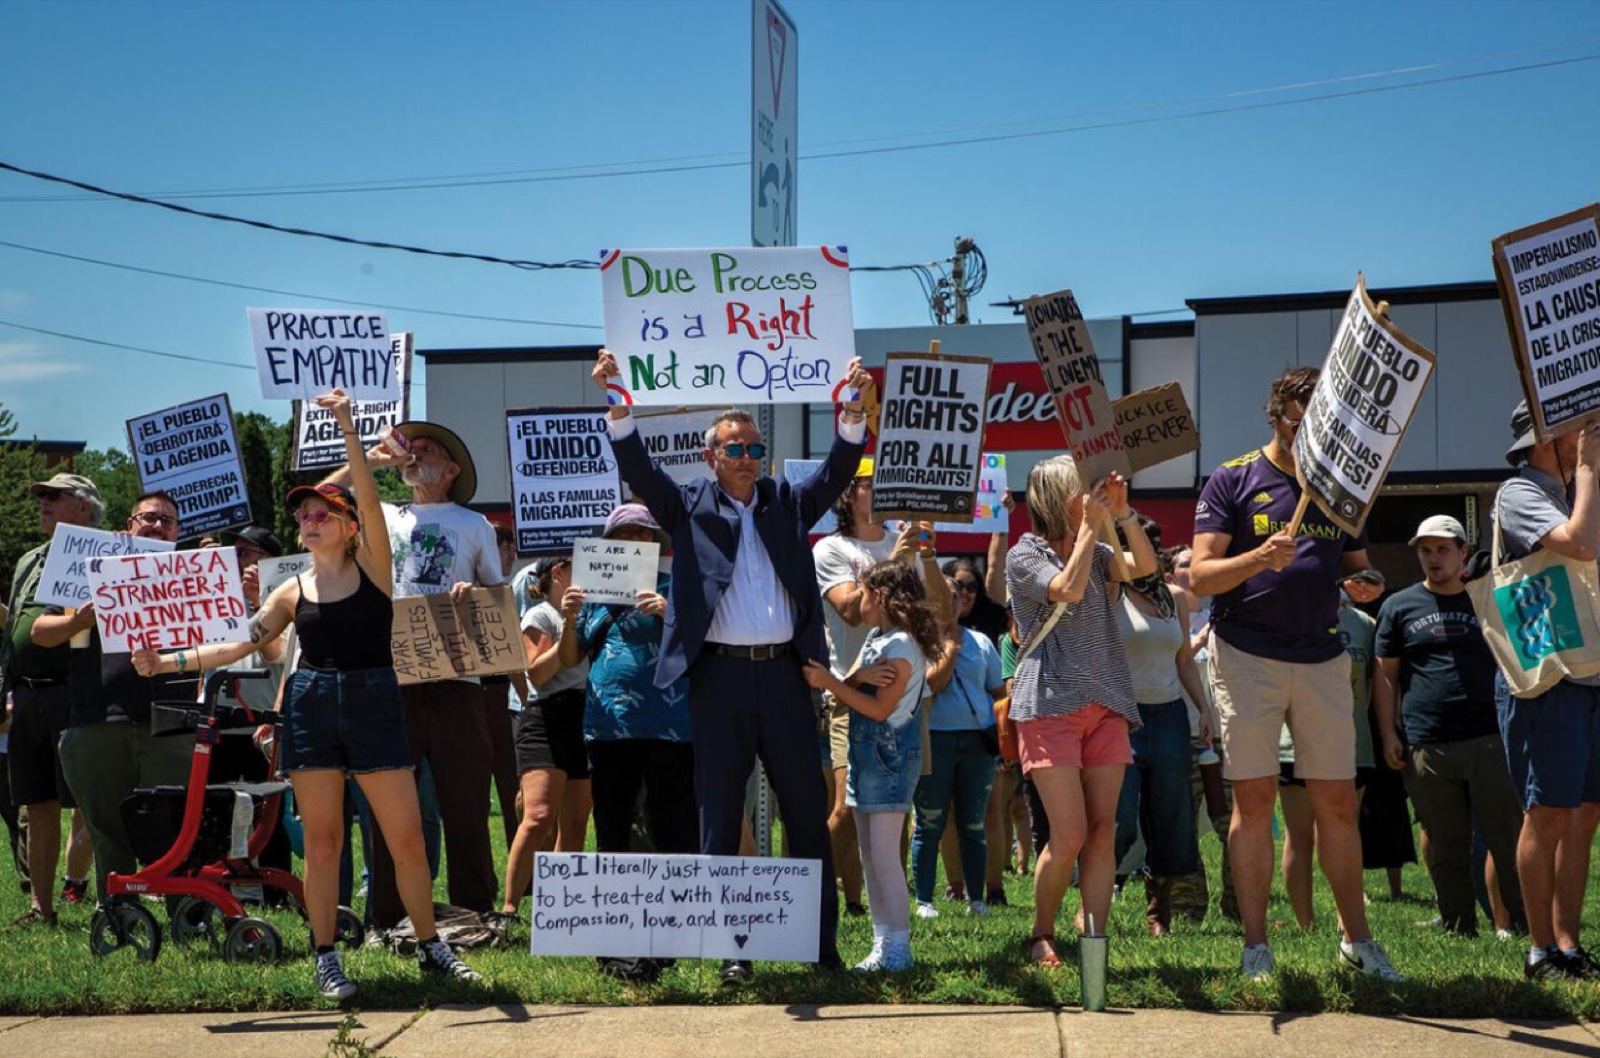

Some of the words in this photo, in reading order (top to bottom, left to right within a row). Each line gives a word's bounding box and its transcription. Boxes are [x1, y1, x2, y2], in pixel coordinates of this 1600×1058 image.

[1511, 229, 1597, 275] IMPERIALISMO
[621, 255, 698, 298] Due
[710, 252, 817, 294] Process
[265, 311, 385, 341] PRACTICE
[641, 309, 669, 342] is
[683, 314, 707, 339] a
[725, 294, 818, 351] Right
[1524, 300, 1551, 331] LA
[1047, 326, 1084, 358] THE
[1358, 317, 1420, 382] PUEBLO
[1531, 335, 1552, 361] DE
[1553, 329, 1571, 354] LA
[1572, 317, 1600, 346] CRIS
[265, 344, 393, 390] EMPATHY
[629, 349, 682, 391] Not
[692, 364, 726, 389] an
[737, 346, 831, 400] Option
[1338, 322, 1399, 408] UNIDO
[1536, 346, 1600, 389] MIGRATO
[899, 365, 965, 399] FULL
[138, 421, 161, 441] ¡EL
[162, 403, 221, 431] PUEBLO
[884, 399, 979, 433] RIGHTS
[1115, 407, 1146, 426] UCK
[1149, 399, 1178, 417] ICE
[145, 420, 223, 456] DERROTARÁ
[516, 420, 542, 440] ¡EL
[545, 418, 608, 435] PUEBLO
[645, 434, 669, 453] NO
[1123, 415, 1190, 449] OREVER
[144, 458, 165, 476] LA
[168, 439, 232, 469] AGENDA
[525, 435, 602, 460] UNIDO
[879, 440, 921, 467] FOR
[927, 442, 973, 470] ALL
[522, 456, 608, 477] DEFENDERÁ
[876, 468, 971, 487] IMMIGRANTS!
[178, 484, 241, 515] TRUMP!
[520, 492, 529, 505] A
[532, 491, 555, 504] LAS
[558, 488, 616, 502] FAMILIAS
[154, 551, 203, 577] WAS
[208, 550, 228, 573] A
[582, 545, 598, 553] WE
[605, 546, 626, 555] ARE
[634, 548, 642, 556] A
[66, 561, 86, 577] AR
[277, 561, 305, 574] STOP
[581, 589, 637, 599] MMIGRANTS!
[98, 605, 143, 638] YOU
[143, 596, 245, 628] INVITED
[1408, 612, 1469, 634] FORTUNATE
[126, 629, 161, 651] ME
[409, 605, 441, 680] FAMILIES
[431, 632, 446, 657] IS
[570, 855, 588, 876] I
[595, 855, 657, 880] literally
[662, 860, 701, 880] just
[708, 859, 749, 878] want
[752, 865, 810, 886] everyone
[536, 886, 556, 907] to
[563, 885, 586, 908] be
[592, 884, 664, 908] treated
[534, 911, 634, 936] Compassion,
[643, 908, 683, 929] love,
[686, 909, 718, 928] and
[723, 907, 788, 933] respect.
